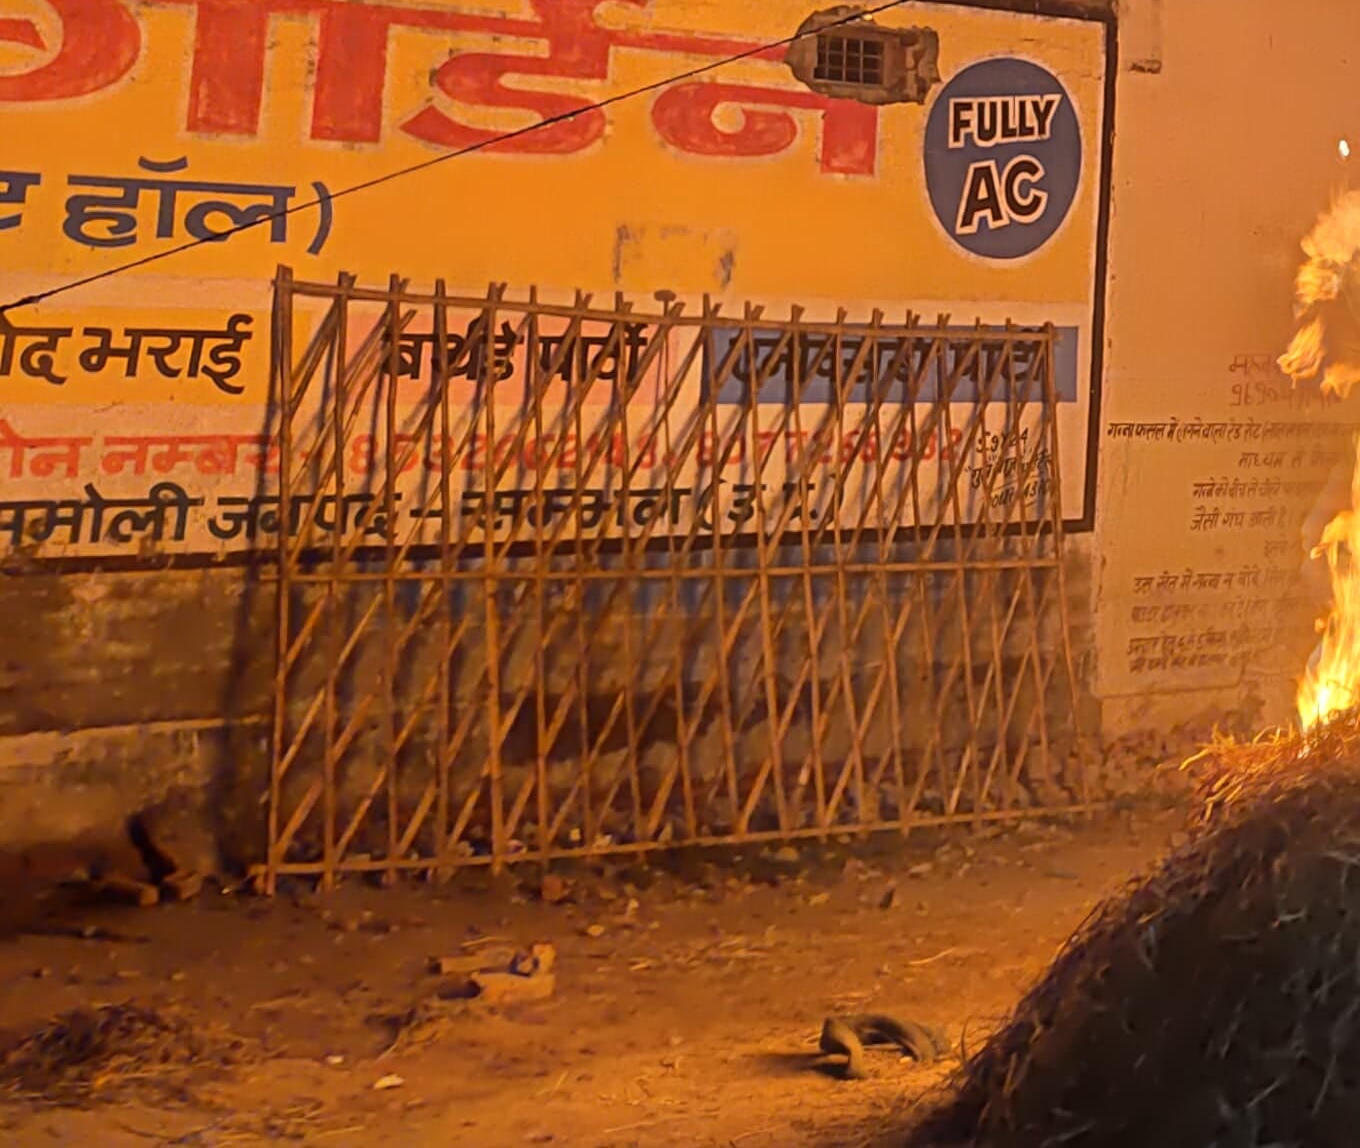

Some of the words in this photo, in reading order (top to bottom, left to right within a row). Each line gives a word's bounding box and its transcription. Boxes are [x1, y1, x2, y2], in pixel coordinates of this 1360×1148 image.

[949, 95, 1062, 148] FULLY
[956, 155, 1047, 234] AC
[0, 312, 72, 385] ोद
[79, 313, 255, 395] भराई
[0, 418, 93, 479] ोन
